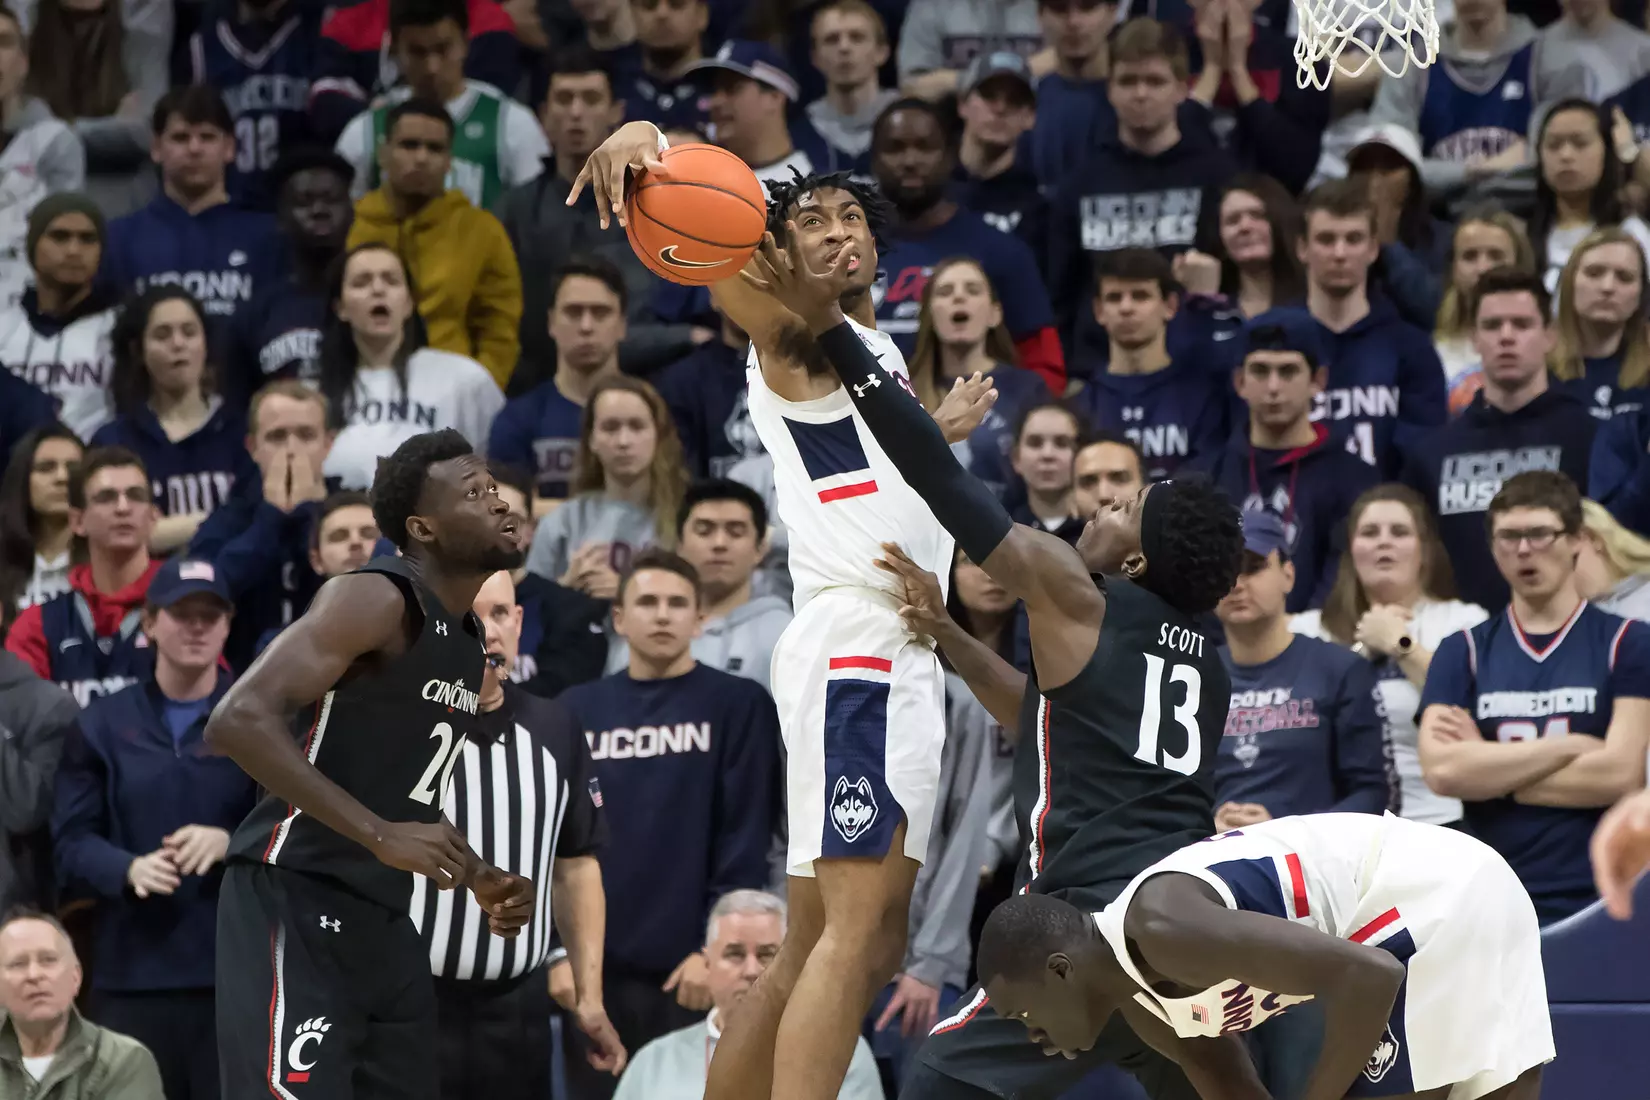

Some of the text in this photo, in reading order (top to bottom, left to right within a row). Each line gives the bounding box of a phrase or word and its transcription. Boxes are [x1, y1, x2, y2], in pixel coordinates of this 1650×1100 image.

[1080, 187, 1202, 220] UCONN
[1082, 214, 1198, 251] HUSKIES
[350, 399, 437, 429] ONN
[1441, 446, 1561, 480] UCONN
[1158, 622, 1205, 658] SCOTT
[1133, 652, 1202, 777] 13
[1477, 686, 1597, 720] CONNECTICUT
[585, 721, 711, 760] UCONN
